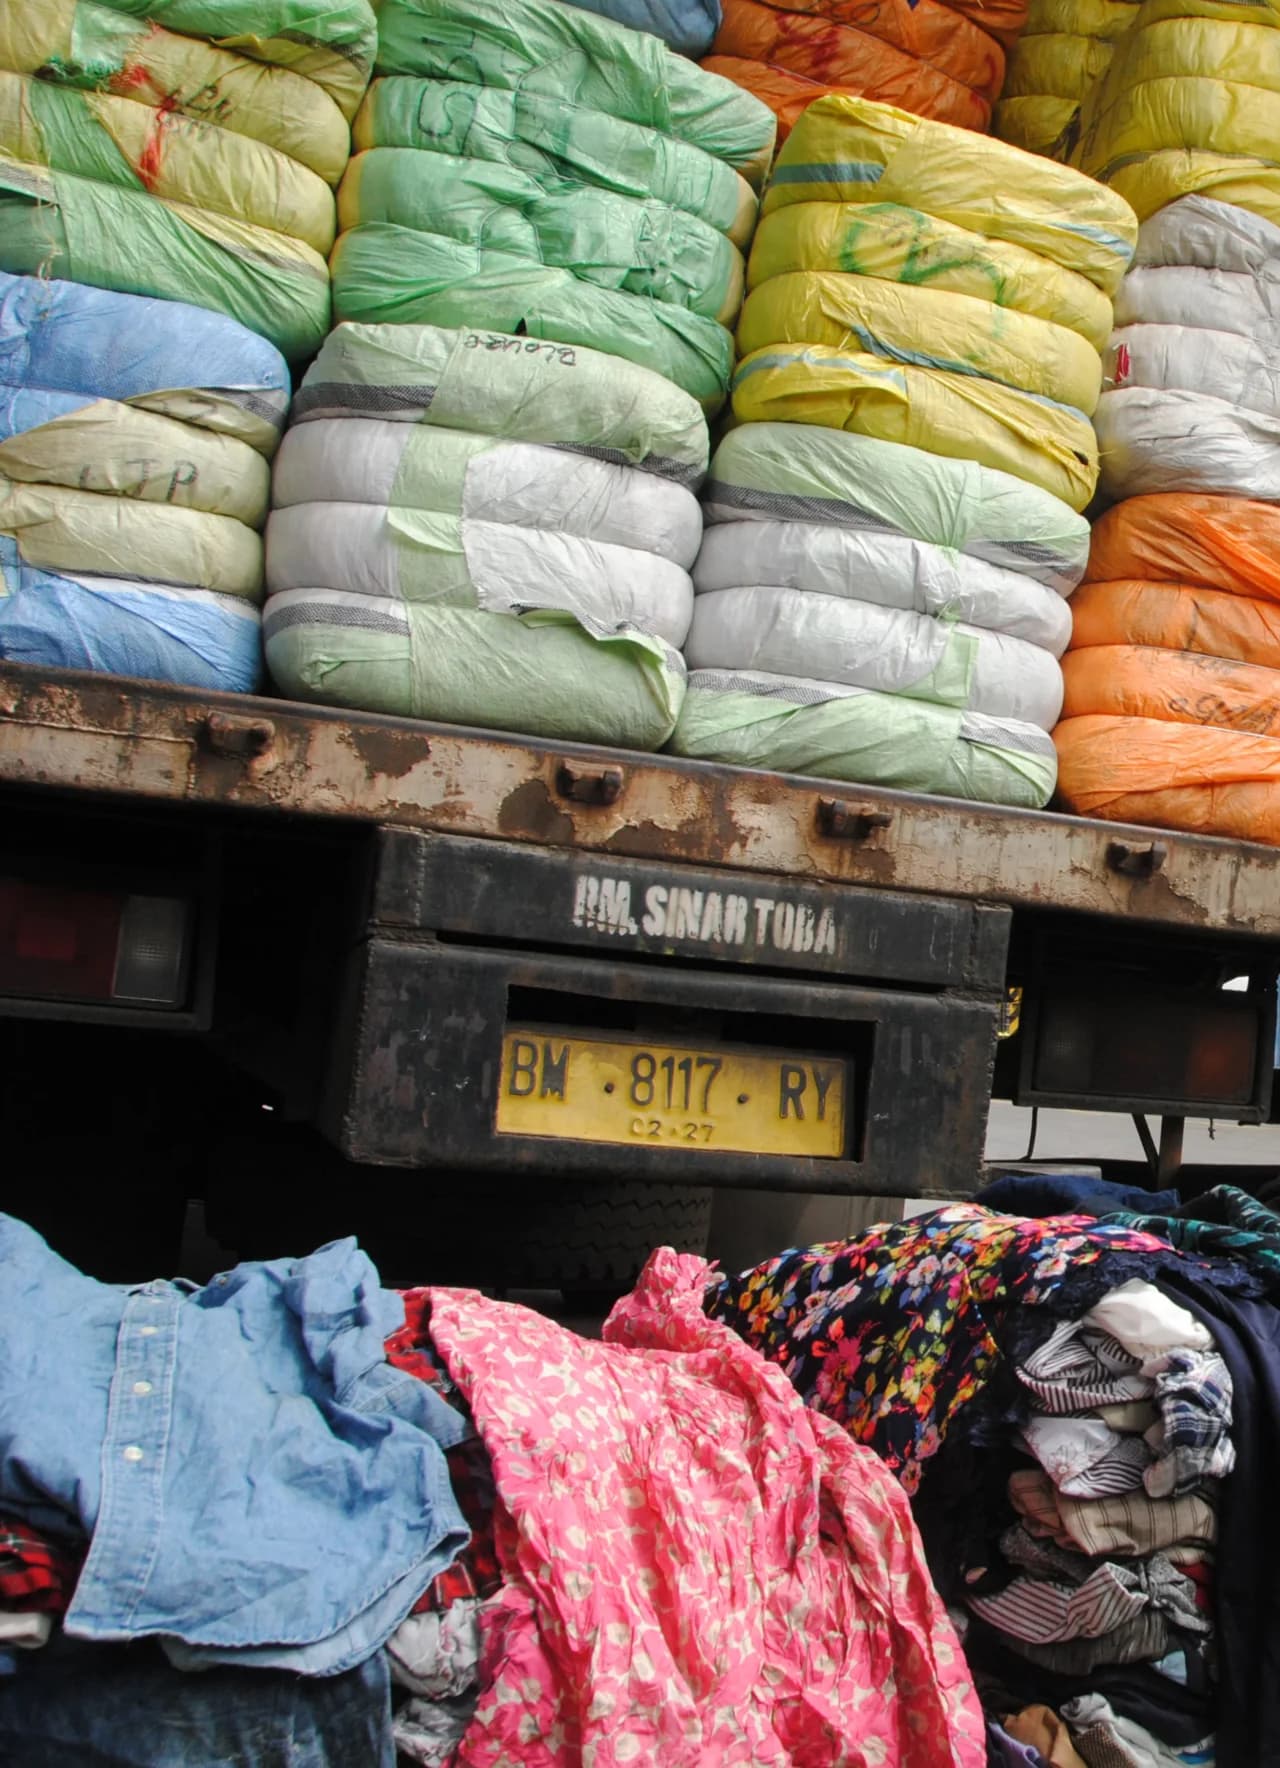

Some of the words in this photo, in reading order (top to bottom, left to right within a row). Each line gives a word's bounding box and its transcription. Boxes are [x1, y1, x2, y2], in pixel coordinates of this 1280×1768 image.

[643, 884, 748, 945] SINAR
[755, 897, 837, 955] TOBA
[508, 1039, 569, 1101] BM
[631, 1052, 722, 1115] 8117
[779, 1063, 834, 1121] RY
